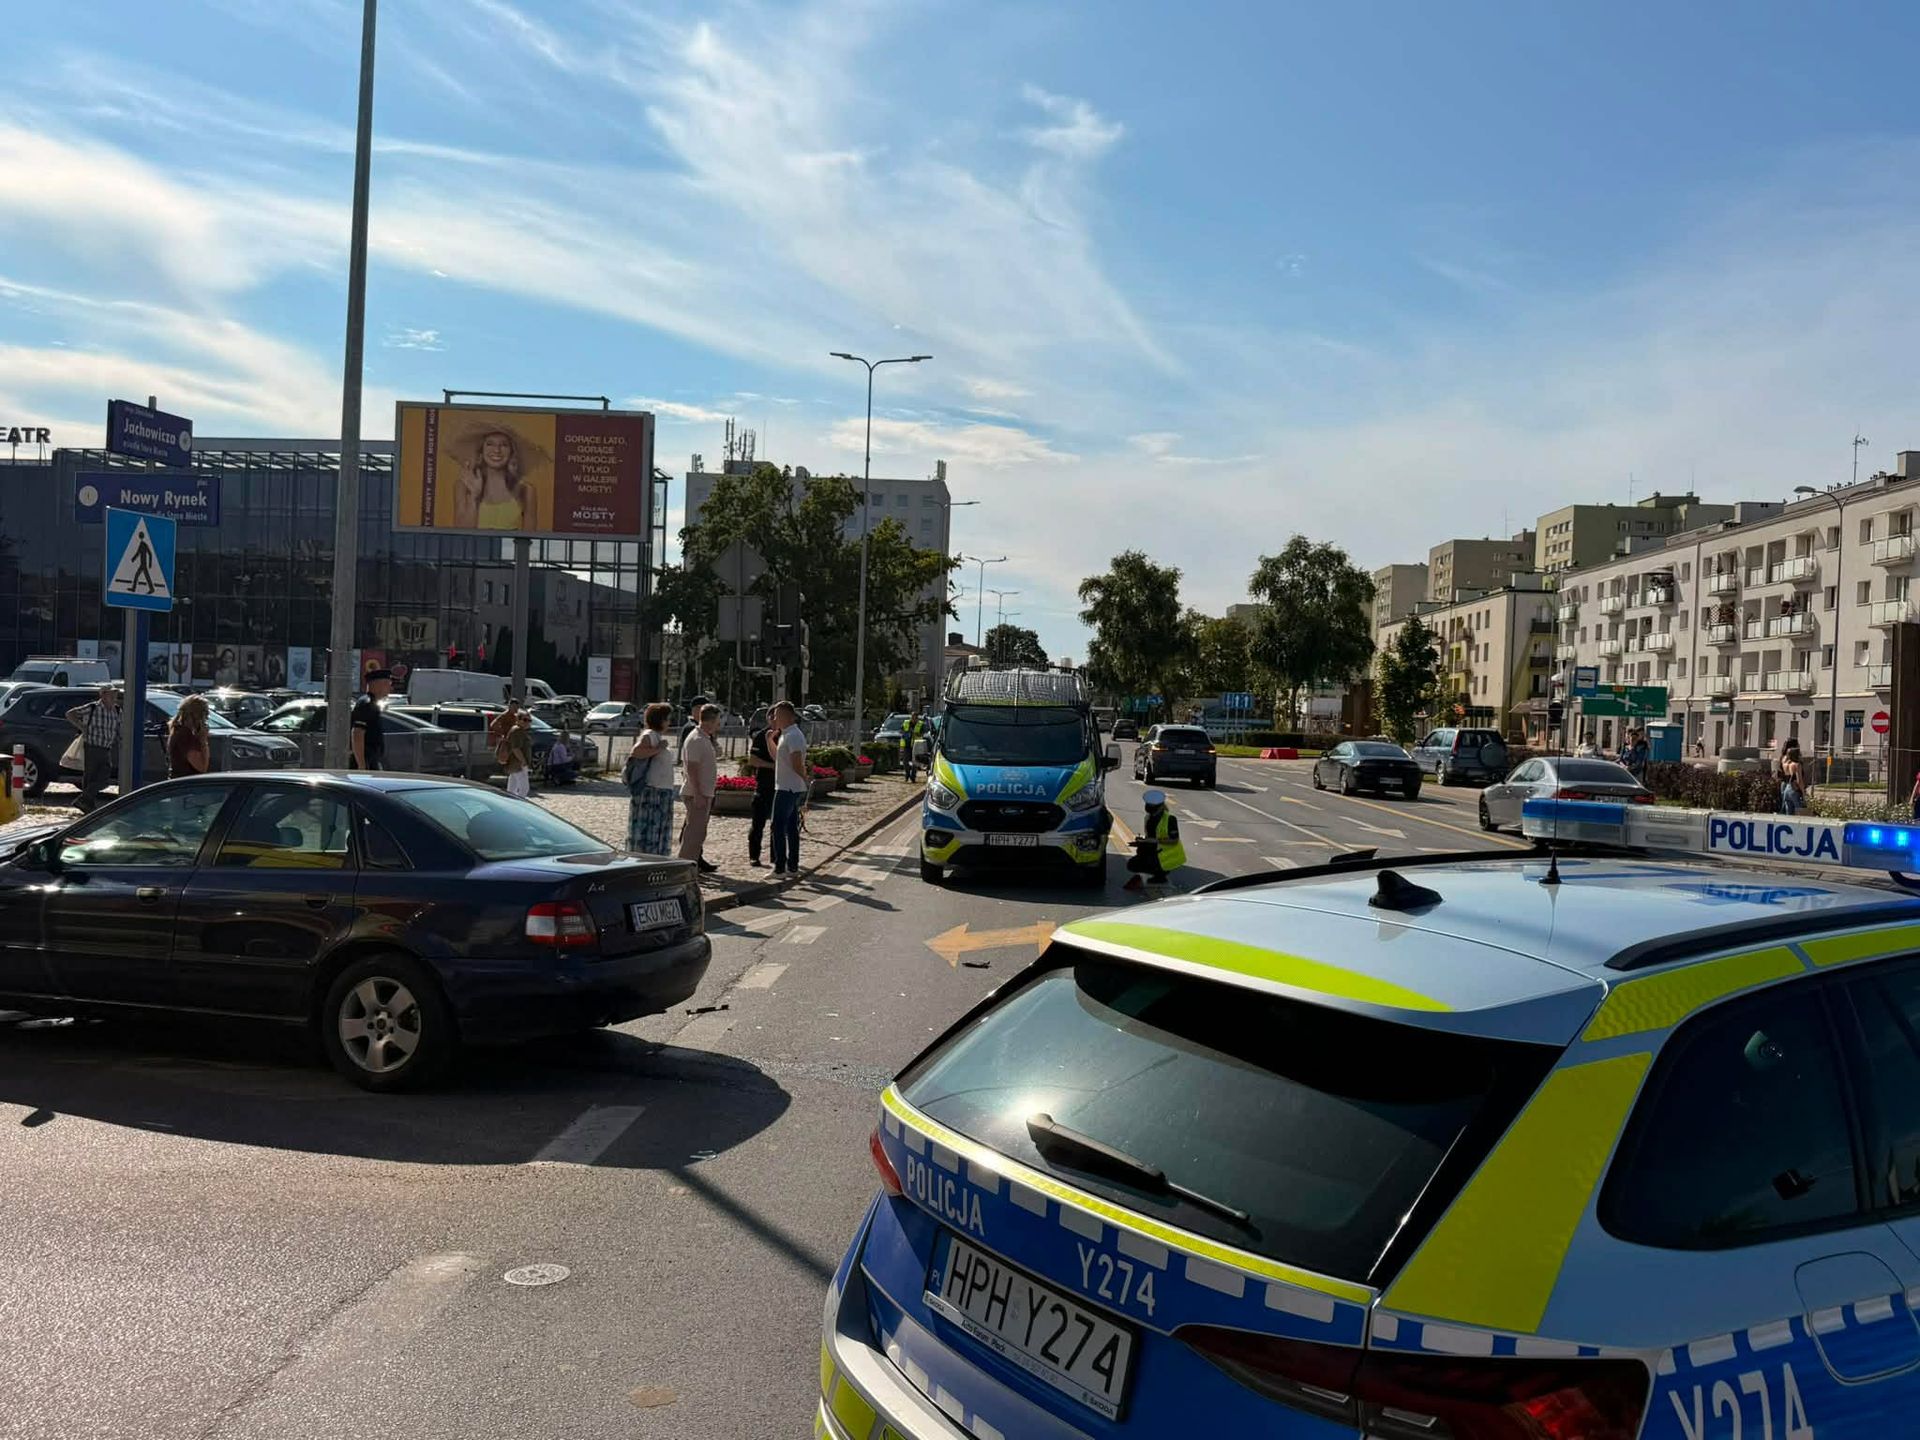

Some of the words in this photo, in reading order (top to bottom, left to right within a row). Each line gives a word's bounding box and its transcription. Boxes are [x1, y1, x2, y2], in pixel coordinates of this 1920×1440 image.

[123, 418, 176, 445] Jachowicza
[572, 474, 581, 482] W
[582, 465, 610, 473] TYLKO
[120, 488, 160, 507] Nowy
[165, 491, 207, 509] Rynek
[572, 511, 616, 520] MOSTY
[975, 782, 1047, 797] POLICJA
[1710, 818, 1839, 860] POLICJA
[587, 882, 605, 893] A4
[637, 904, 659, 924] EKU
[907, 1154, 985, 1236] POLICJA
[1077, 1242, 1156, 1316] Y274
[931, 1270, 941, 1287] PL
[947, 1246, 1013, 1331] HPH
[1024, 1287, 1121, 1394] Y274
[1668, 1362, 1814, 1440] Y274
